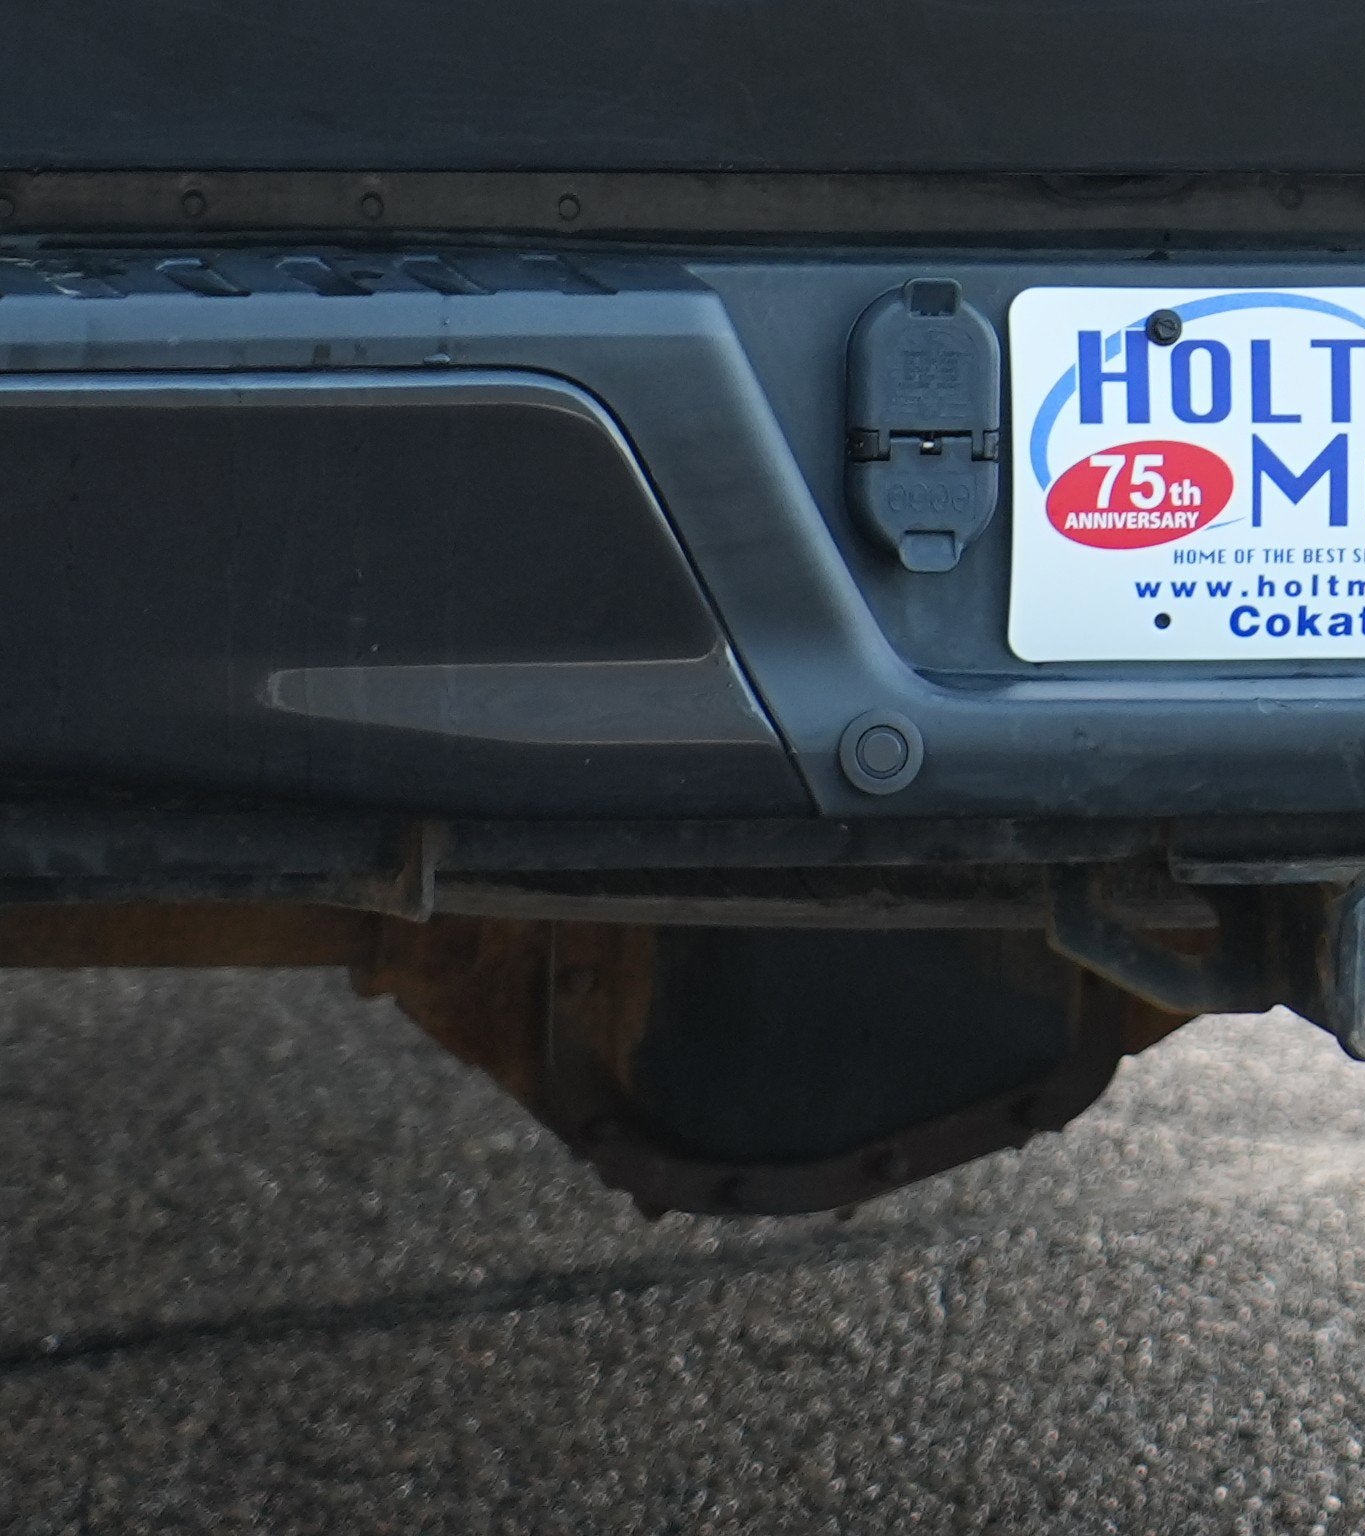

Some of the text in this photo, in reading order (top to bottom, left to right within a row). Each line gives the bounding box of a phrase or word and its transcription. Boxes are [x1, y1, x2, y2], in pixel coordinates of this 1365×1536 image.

[1089, 453, 1202, 510] 75th
[1064, 510, 1199, 531] ANNIVERSARY
[1173, 549, 1226, 564] HOME
[1234, 549, 1255, 563] OF
[1263, 549, 1295, 563] THE
[1303, 548, 1345, 563] BEST
